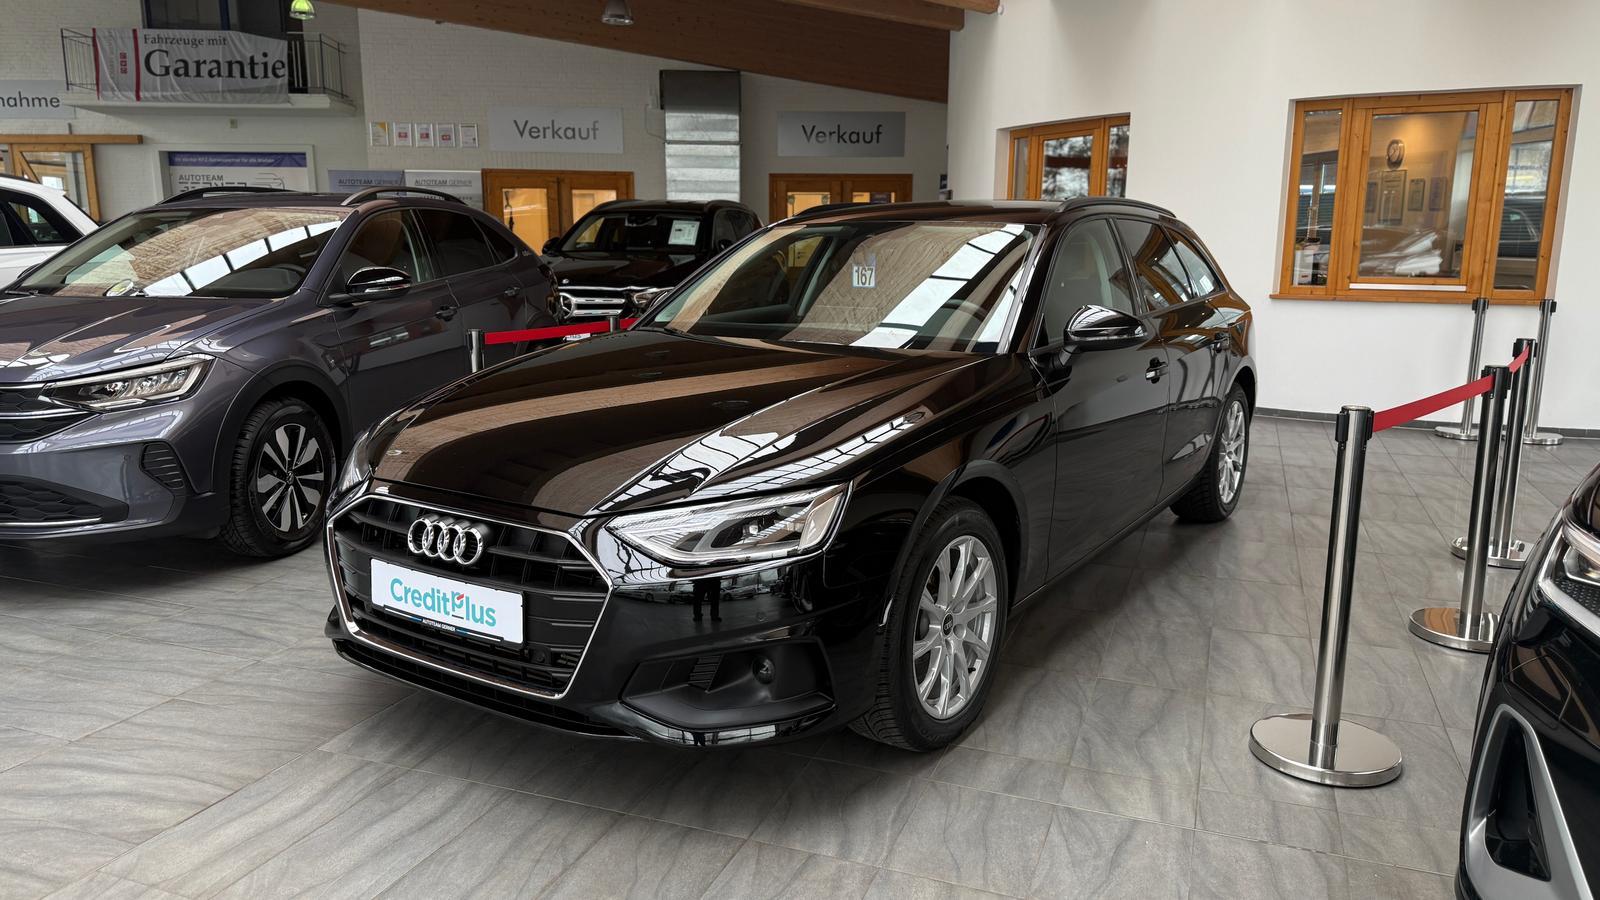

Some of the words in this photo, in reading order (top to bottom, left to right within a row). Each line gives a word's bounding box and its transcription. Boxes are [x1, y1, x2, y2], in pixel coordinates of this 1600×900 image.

[144, 34, 204, 48] Fahrzeuge
[208, 36, 228, 46] mit
[144, 49, 286, 80] Garantie
[513, 119, 599, 140] Verkauf
[801, 124, 883, 144] Verkauf
[178, 174, 224, 182] AUTOTEAM
[855, 267, 874, 286] 167
[390, 577, 497, 627] CreditPlus
